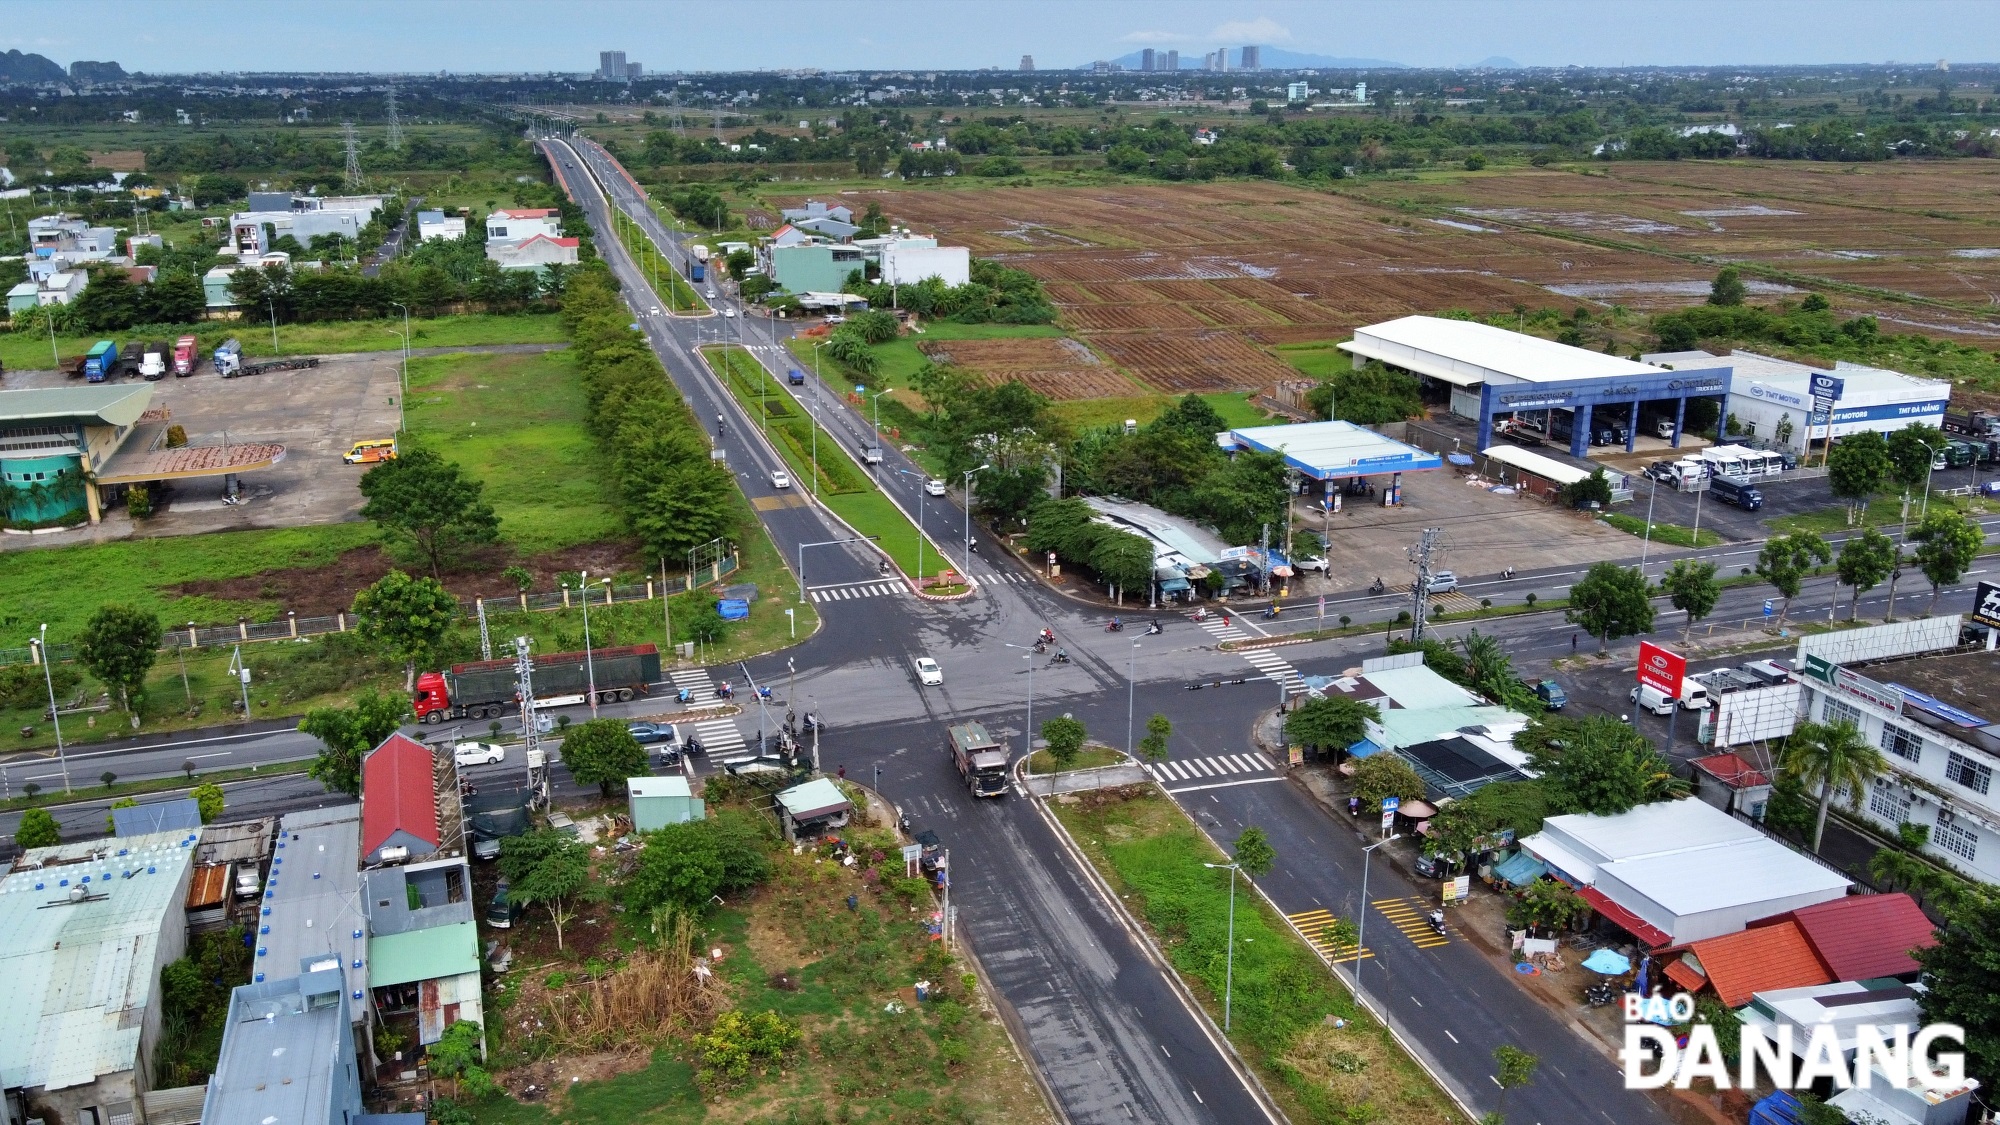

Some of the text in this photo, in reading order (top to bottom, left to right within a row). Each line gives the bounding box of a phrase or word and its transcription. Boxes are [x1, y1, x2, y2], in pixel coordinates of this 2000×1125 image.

[1765, 390, 1801, 404] TMT MOTOR
[1842, 411, 1868, 420] MOTORS
[1644, 663, 1673, 681] TERACO
